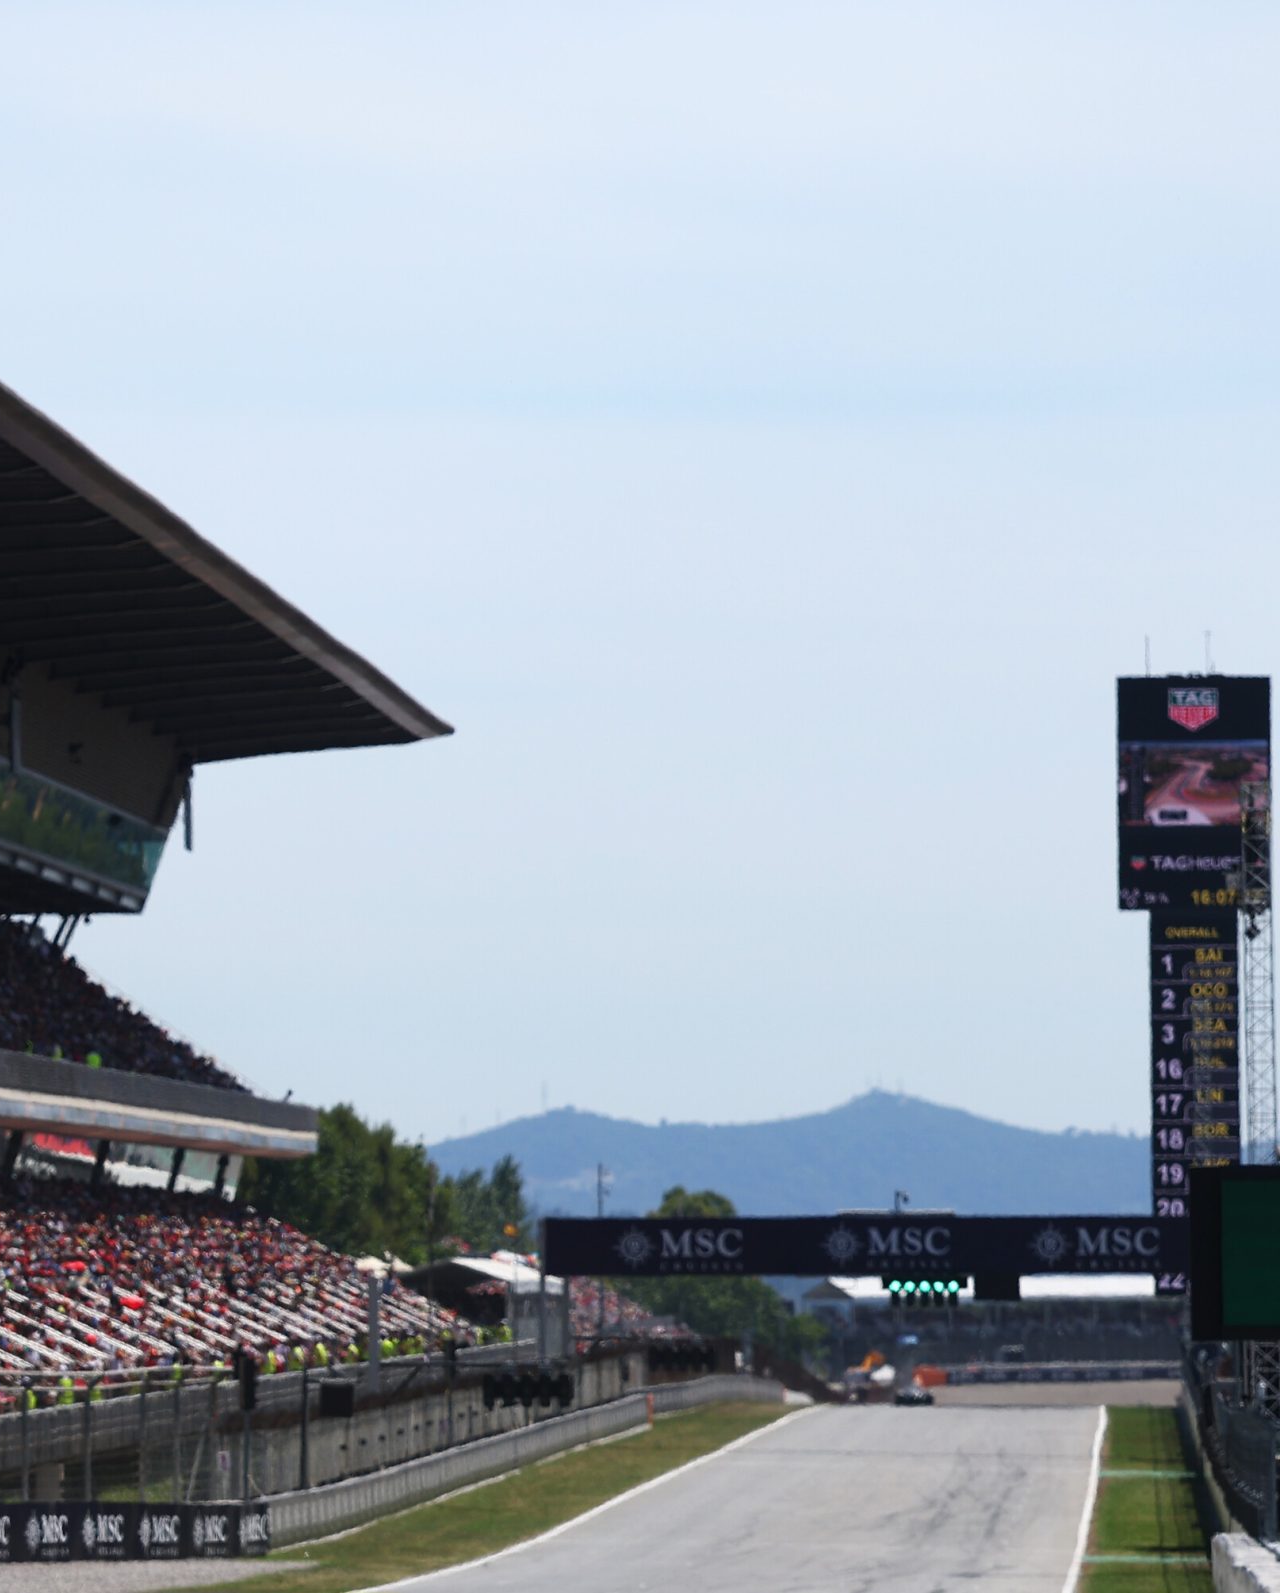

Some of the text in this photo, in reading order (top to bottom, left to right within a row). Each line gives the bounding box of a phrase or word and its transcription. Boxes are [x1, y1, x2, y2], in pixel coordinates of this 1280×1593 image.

[1173, 690, 1215, 705] TAG
[1161, 954, 1173, 975] 1
[1161, 988, 1176, 1010] 2
[1162, 1023, 1175, 1044] 3
[1156, 1058, 1183, 1079] 16
[1156, 1093, 1183, 1114] 17
[1157, 1128, 1184, 1150] 18
[1157, 1163, 1184, 1185] 19
[1157, 1198, 1184, 1217] 20
[661, 1229, 742, 1257] MSC
[869, 1228, 949, 1255] MSC
[1078, 1228, 1159, 1255] MSC
